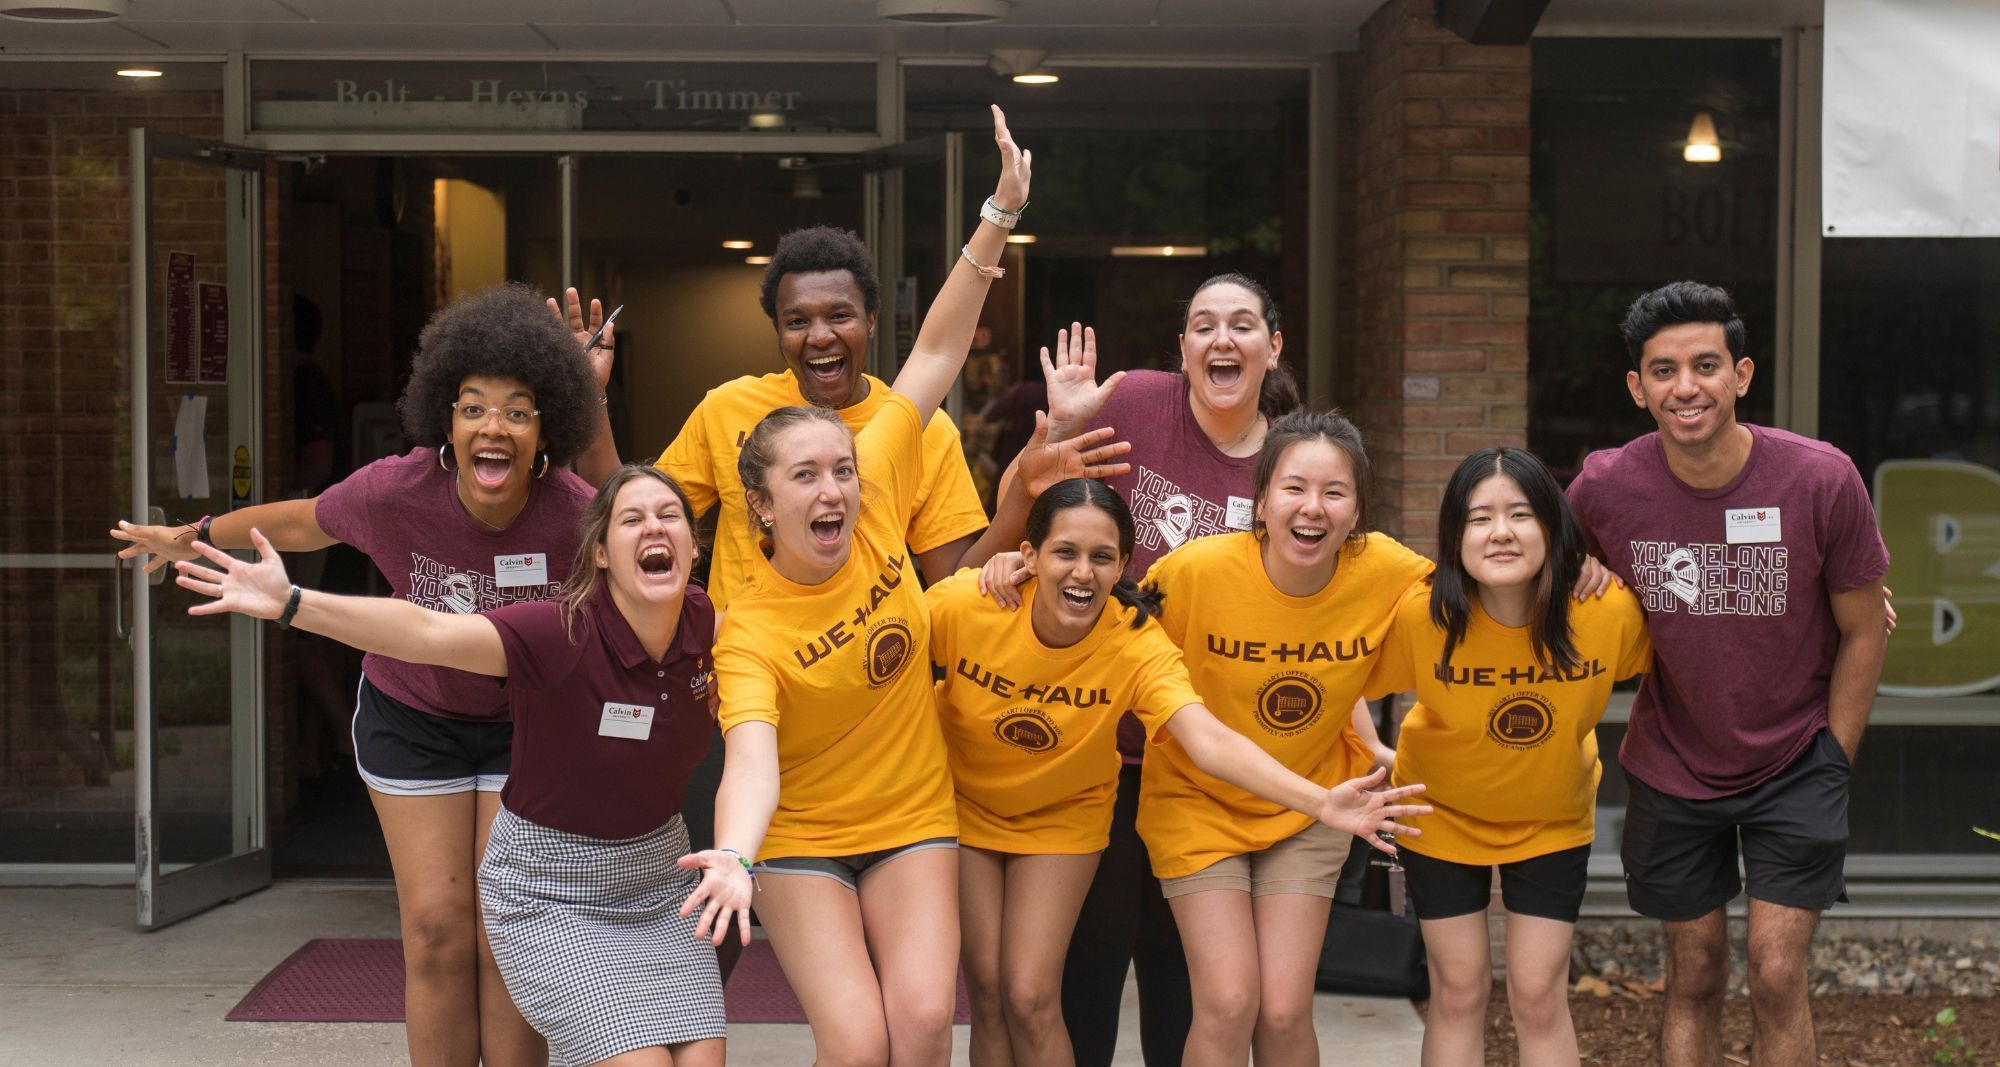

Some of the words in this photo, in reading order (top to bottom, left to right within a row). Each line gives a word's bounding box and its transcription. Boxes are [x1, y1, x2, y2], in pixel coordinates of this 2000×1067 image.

[334, 79, 411, 109] Bolt
[470, 79, 588, 115] Heyns
[645, 80, 800, 111] Timmer
[1731, 513, 1756, 521] Calvin
[1132, 516, 1162, 551] OU
[499, 558, 523, 567] Calvin
[1688, 543, 1788, 570] BELONG
[1701, 568, 1788, 593] ELONG
[1688, 590, 1787, 616] BELONG
[793, 620, 855, 669] WE
[1207, 634, 1267, 663] WE
[1271, 636, 1377, 663] HAUL
[957, 658, 1016, 698] WE
[1018, 684, 1112, 709] HAUL
[1262, 673, 1280, 687] CART
[1285, 670, 1309, 679] OFFER
[1310, 675, 1319, 684] TO
[1434, 663, 1496, 687] WE
[608, 707, 632, 716] Calvin
